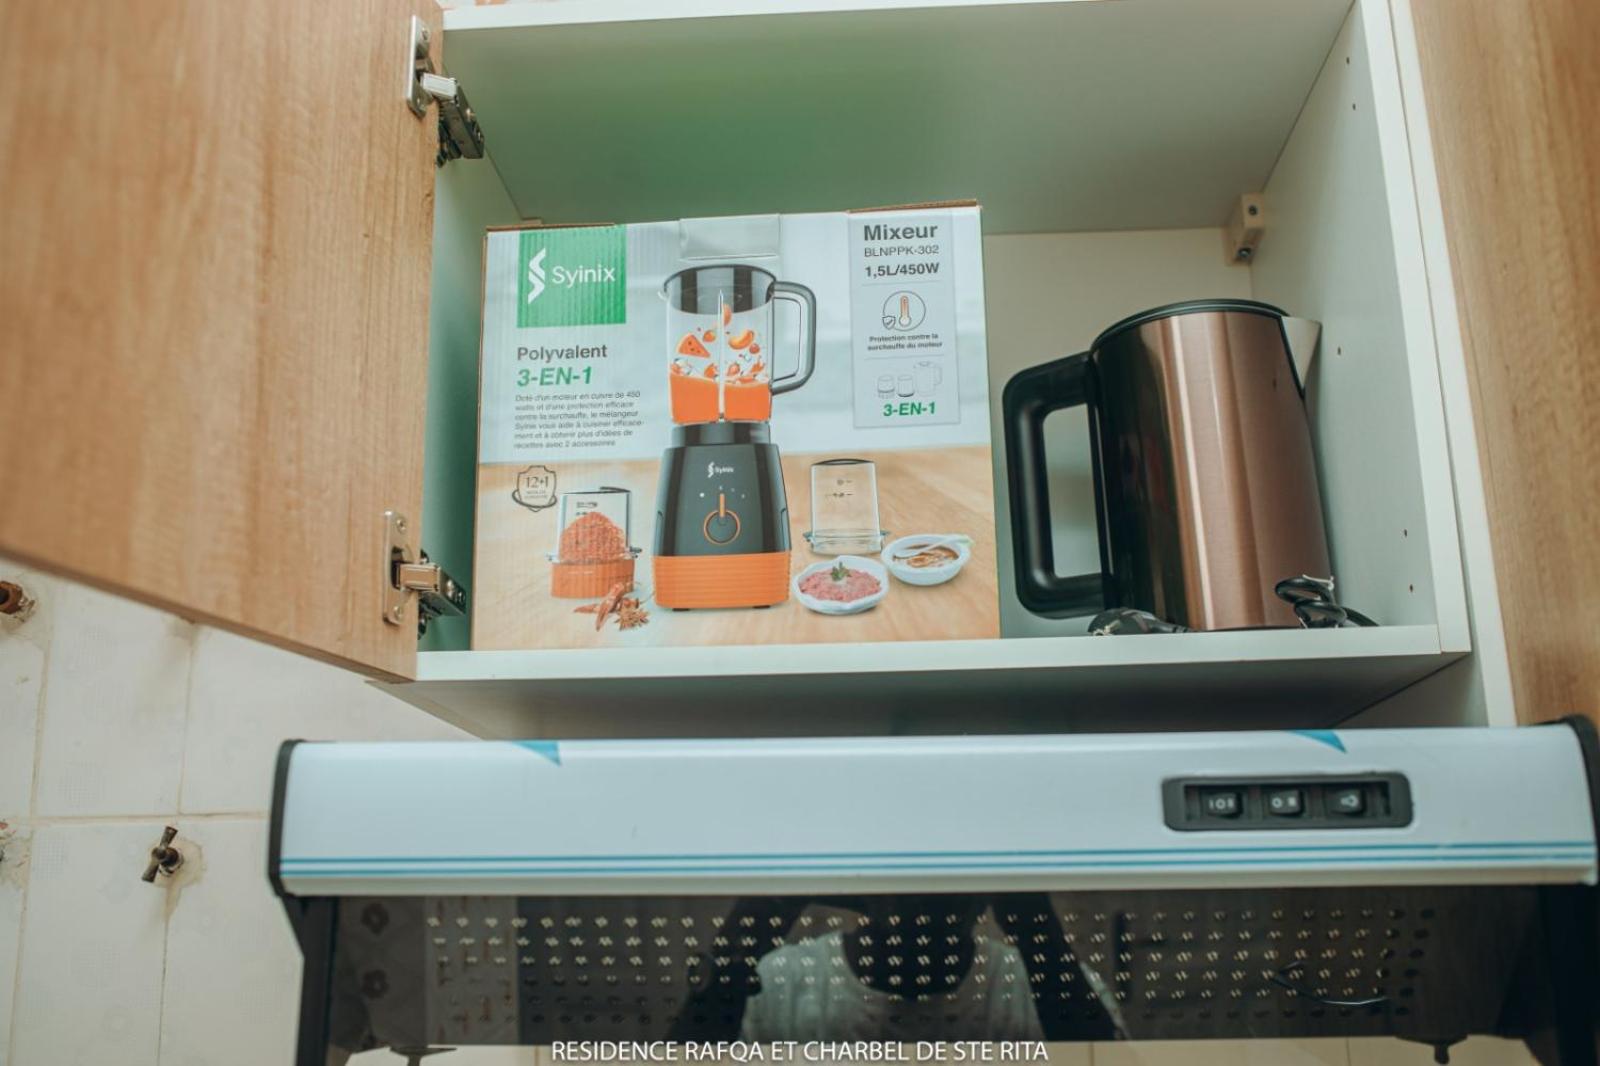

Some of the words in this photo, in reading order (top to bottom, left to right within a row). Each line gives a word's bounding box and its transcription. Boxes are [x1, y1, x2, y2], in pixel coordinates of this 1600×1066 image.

[864, 224, 938, 240] Mixeur
[864, 245, 939, 257] BLNPPK-302
[552, 264, 615, 288] Syinix
[865, 262, 940, 279] 1,5L/450W
[517, 344, 608, 363] Polyvalent
[517, 366, 592, 387] 3-EN-1
[883, 401, 935, 416] 3-EN-1
